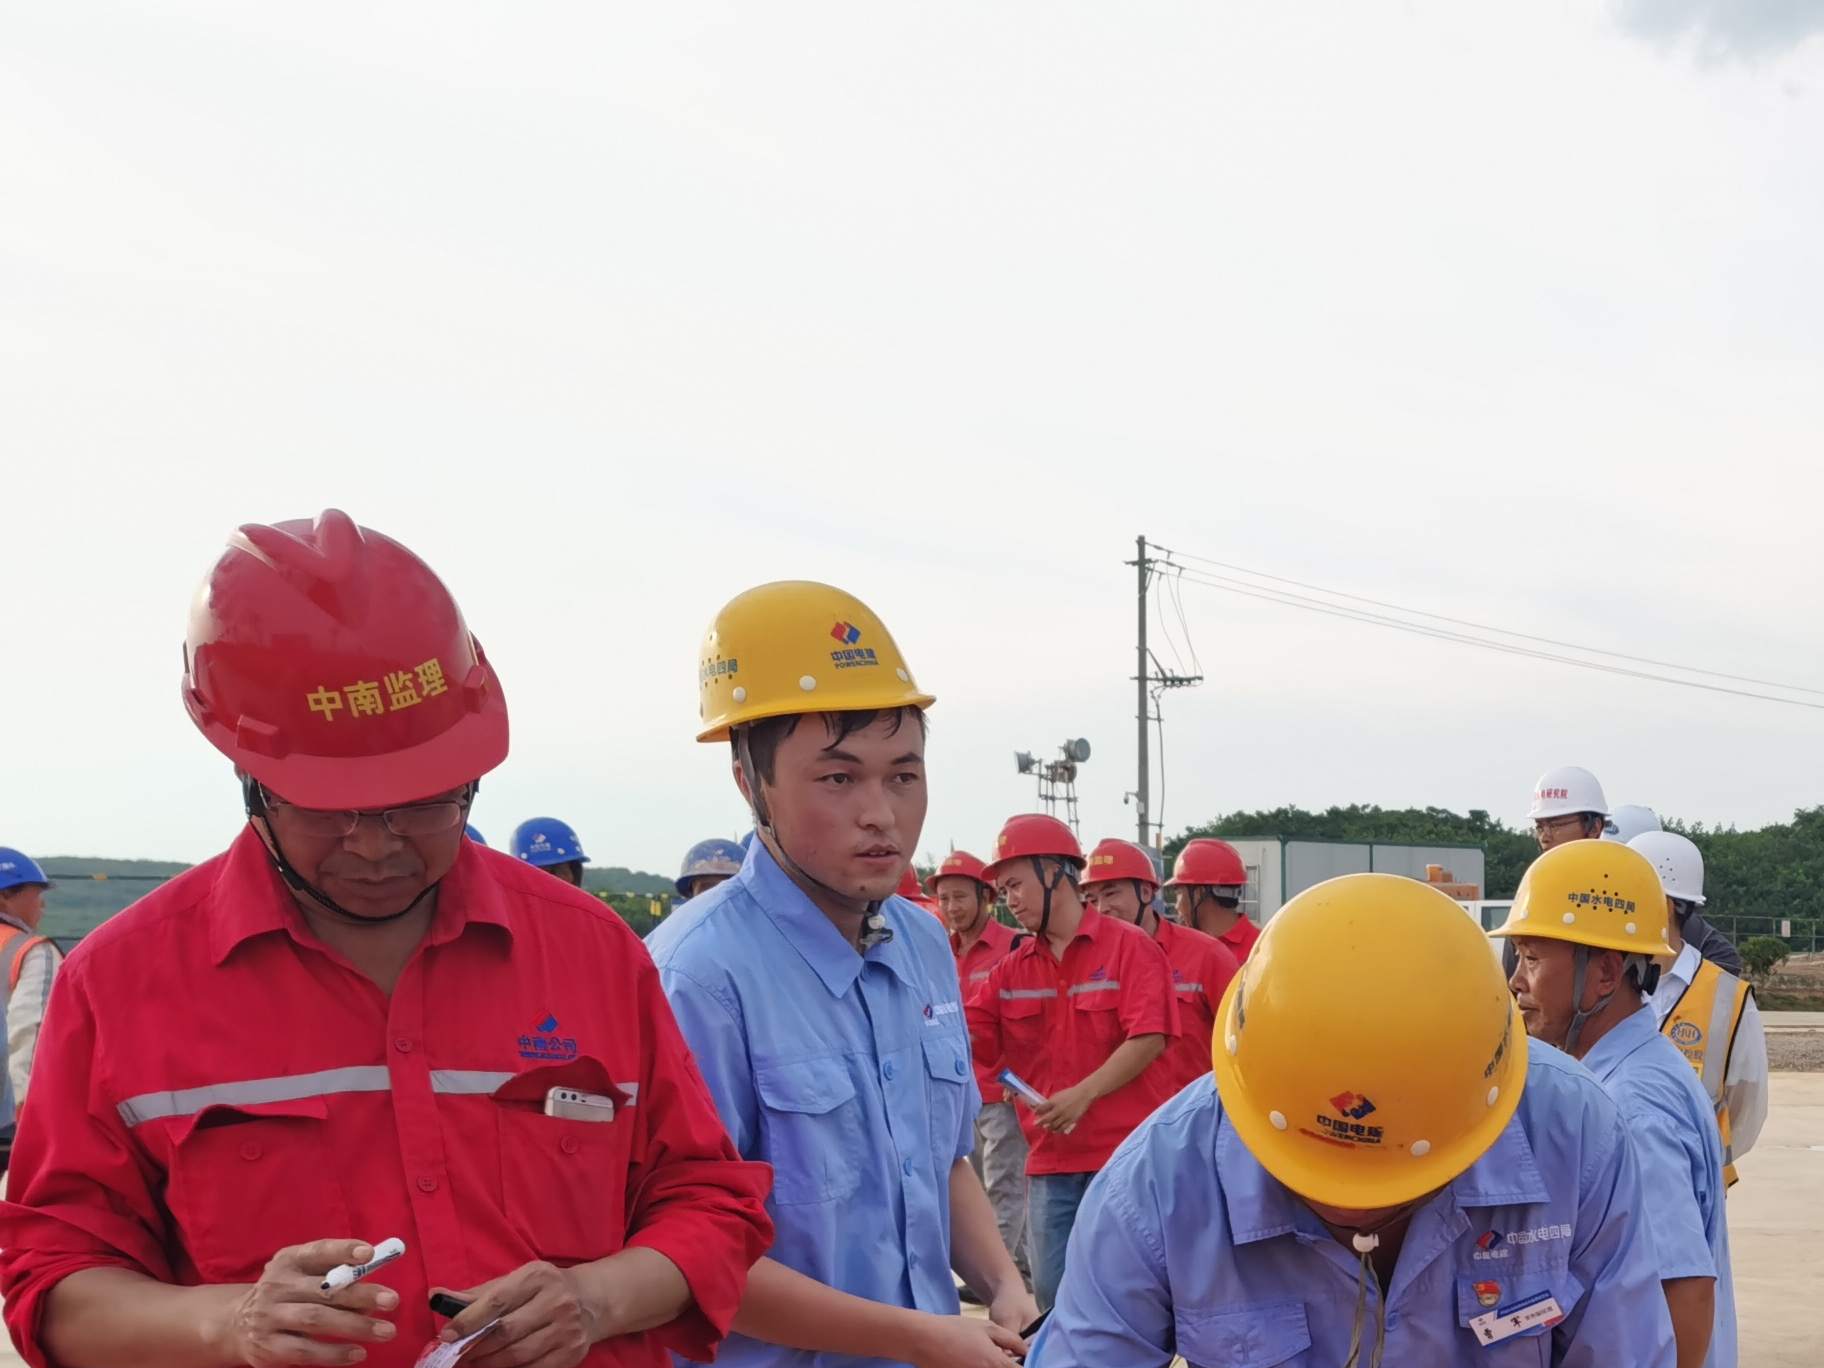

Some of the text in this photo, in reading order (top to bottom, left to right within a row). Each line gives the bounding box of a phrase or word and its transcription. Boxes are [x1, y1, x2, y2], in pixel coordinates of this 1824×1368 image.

[830, 648, 876, 661] 中国电建
[305, 657, 448, 722] 中南监理
[1567, 892, 1635, 913] 中国水电四局
[1317, 1114, 1384, 1138] 中国电建
[1507, 1224, 1571, 1245] 中国水电四局
